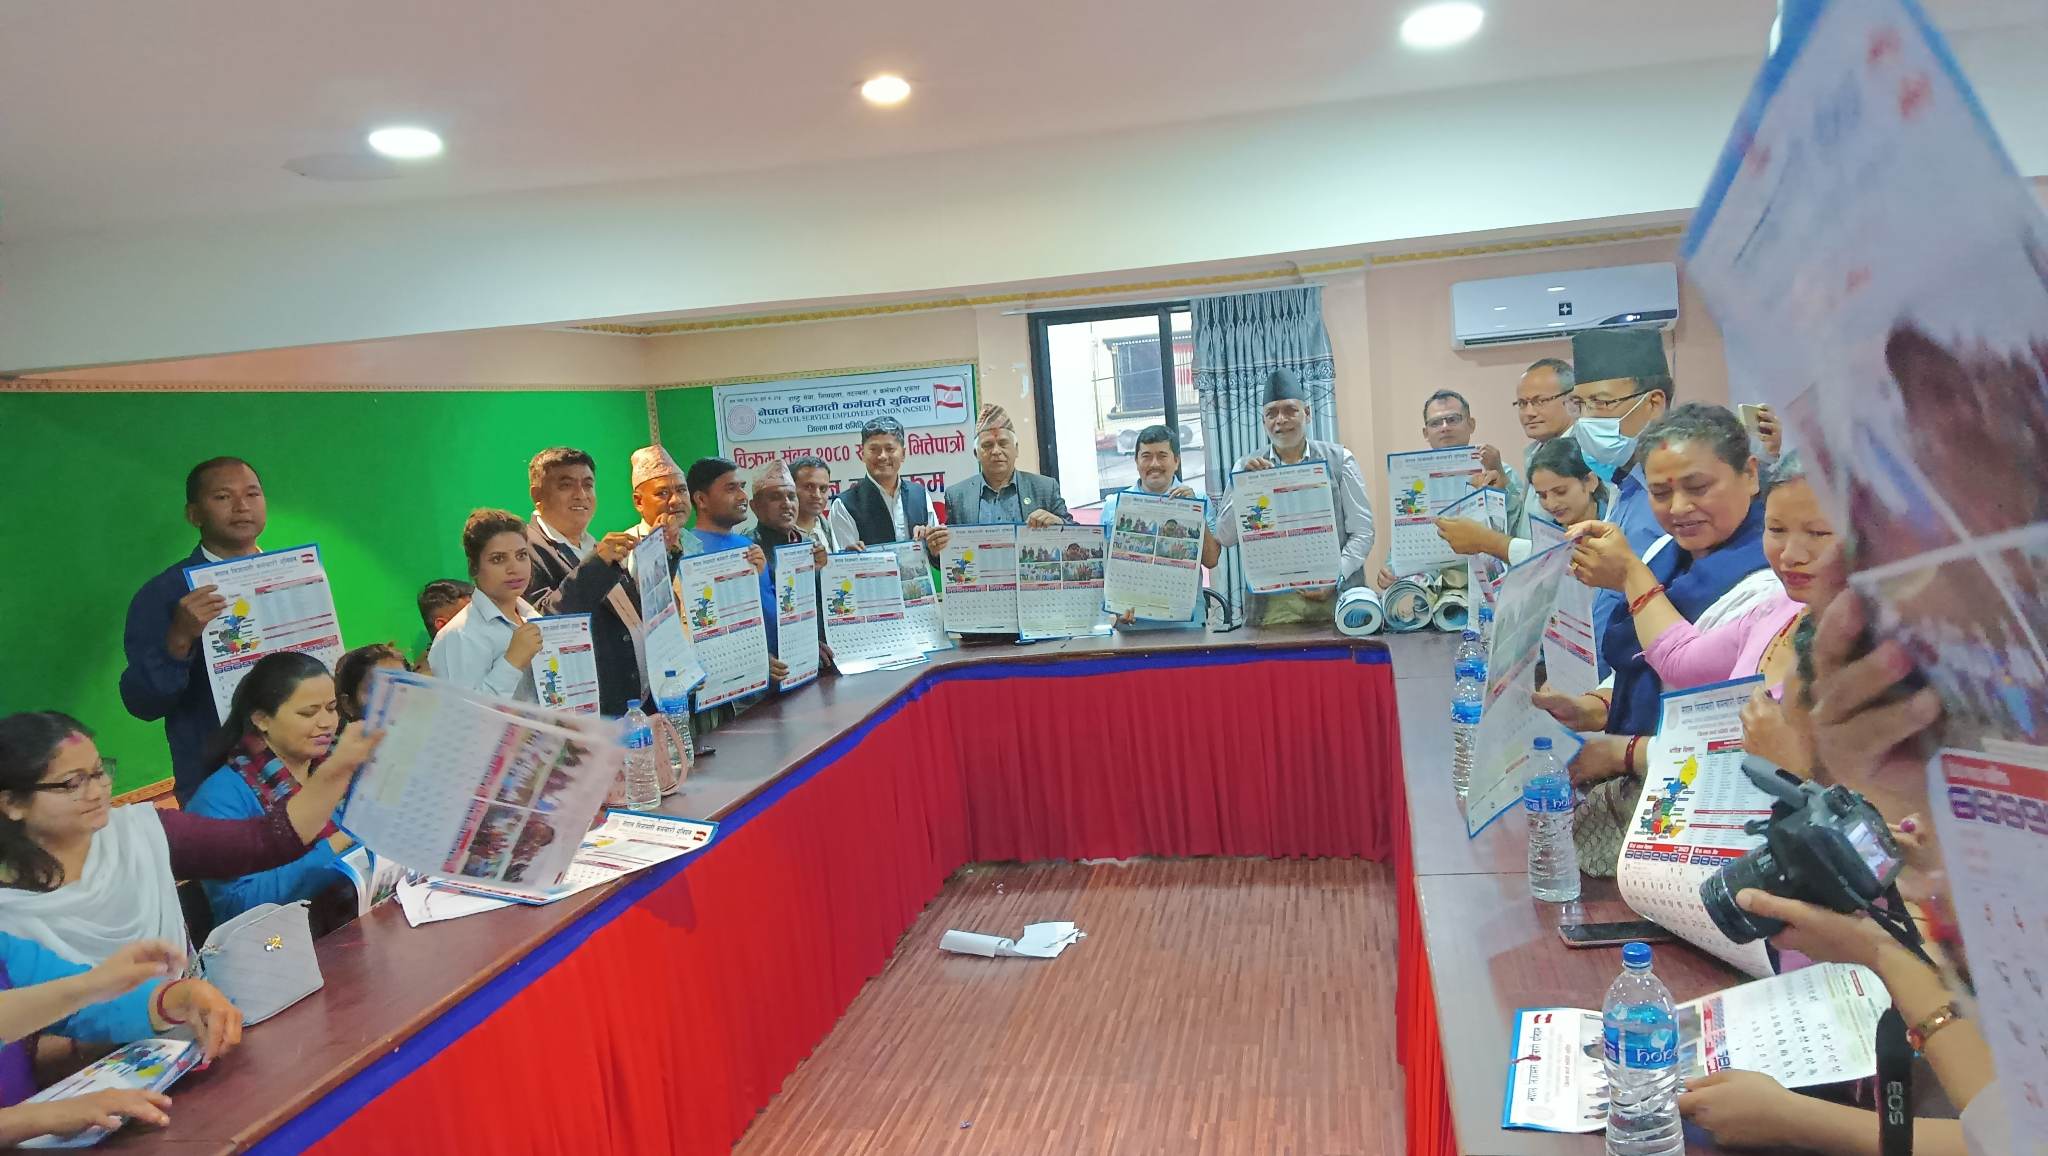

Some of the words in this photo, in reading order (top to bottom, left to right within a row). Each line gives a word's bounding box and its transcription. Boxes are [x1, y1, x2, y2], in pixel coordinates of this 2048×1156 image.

[758, 407, 789, 416] नेपाल
[792, 402, 839, 414] निजामती
[843, 397, 886, 409] कर्मचारी
[759, 417, 782, 425] NEPAL
[783, 415, 801, 423] CIVIL
[802, 413, 831, 421] SERVICE
[877, 406, 901, 416] UNION
[902, 405, 931, 415] (NCSEU)
[816, 445, 850, 462] २०८०
[1887, 1081, 1904, 1125] EOS
